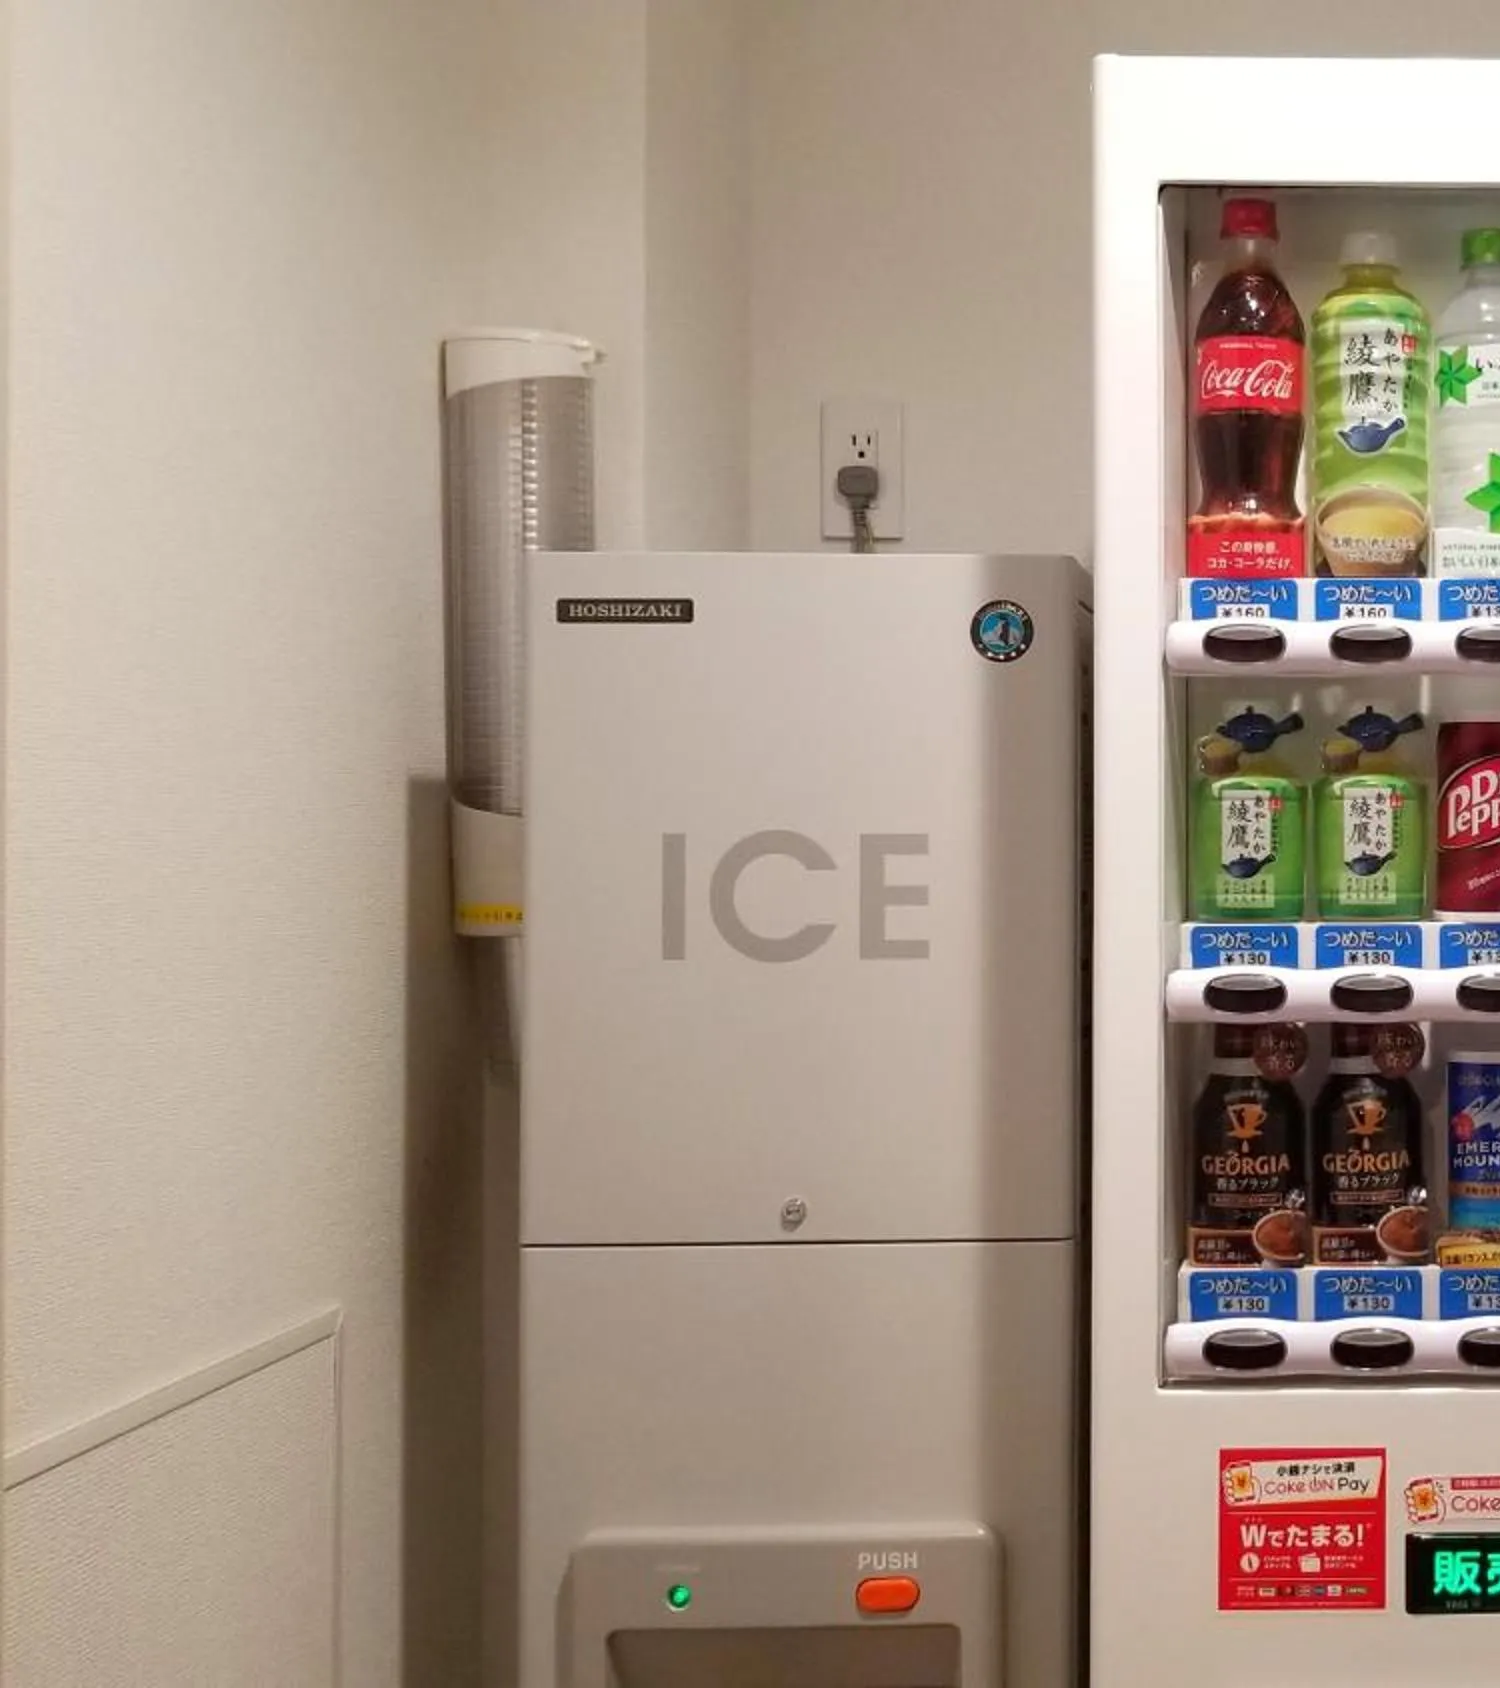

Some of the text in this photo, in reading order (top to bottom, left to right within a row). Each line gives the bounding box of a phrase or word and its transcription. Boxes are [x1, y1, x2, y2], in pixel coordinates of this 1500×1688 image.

[1201, 359, 1295, 399] Coca-Cola
[569, 604, 681, 617] HOSHIZAKI
[661, 828, 930, 963] ICE
[1202, 1151, 1290, 1176] GEORGIA
[1322, 1150, 1410, 1173] GEORGIA
[1264, 1479, 1307, 1495] Coke
[1337, 1477, 1370, 1494] Pay
[1240, 1523, 1364, 1548] Wでたまる!
[857, 1552, 919, 1571] PUSH
